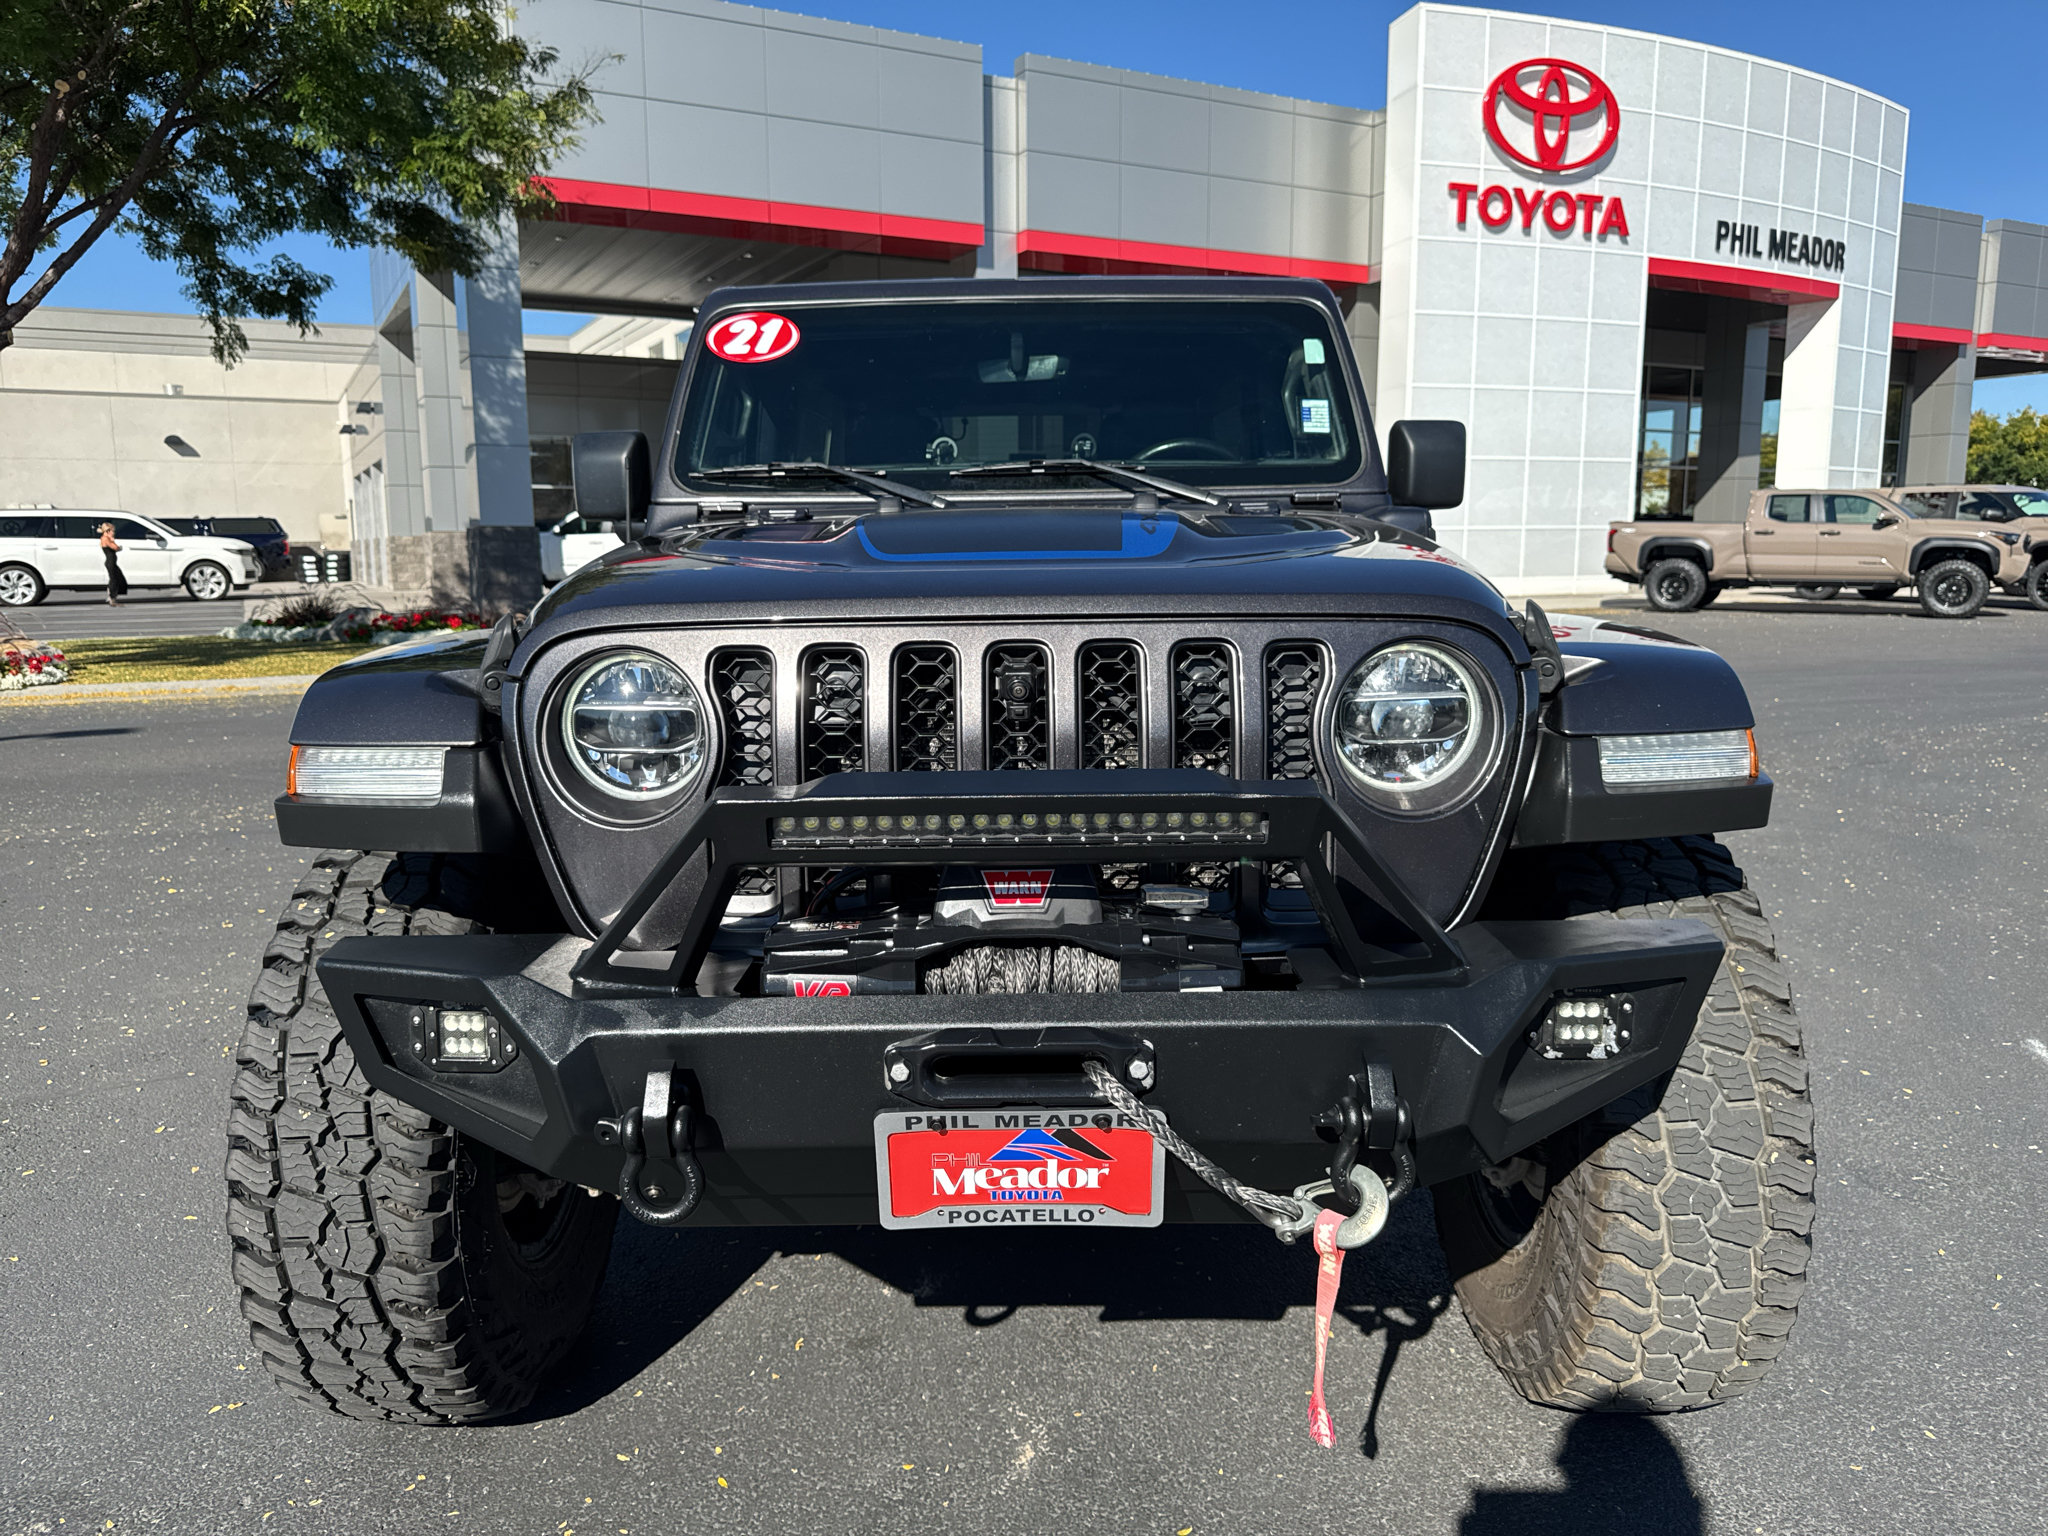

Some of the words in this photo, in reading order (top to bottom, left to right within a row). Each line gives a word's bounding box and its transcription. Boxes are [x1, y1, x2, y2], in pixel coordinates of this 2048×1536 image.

[1447, 181, 1630, 238] TOYOTA
[1715, 219, 1762, 259] PHIL
[1767, 227, 1846, 273] MEADOR
[722, 317, 784, 355] 21
[993, 880, 1042, 895] WARN
[904, 1115, 979, 1131] PHIL
[994, 1113, 1138, 1129] MEADOR
[931, 1152, 992, 1168] PHIL
[931, 1158, 1110, 1197] Meador
[990, 1189, 1064, 1201] TOYOTA
[948, 1208, 1095, 1224] POCATELLO
